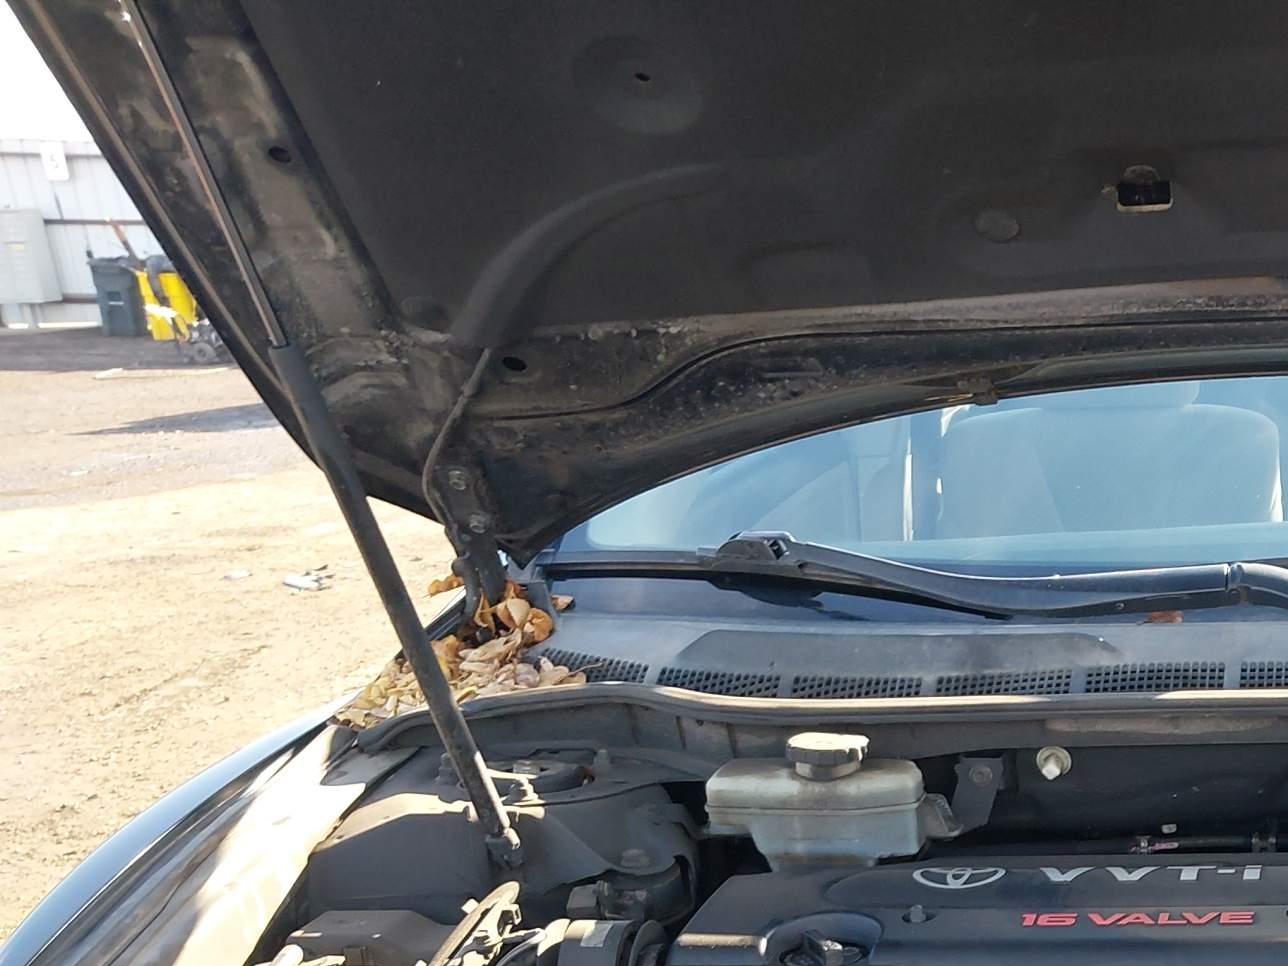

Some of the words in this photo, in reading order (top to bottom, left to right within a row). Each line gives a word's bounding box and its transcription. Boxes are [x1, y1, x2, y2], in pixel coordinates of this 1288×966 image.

[1039, 864, 1263, 882] VVT-i
[1020, 912, 1078, 926] 16
[1087, 911, 1255, 926] VALVE
